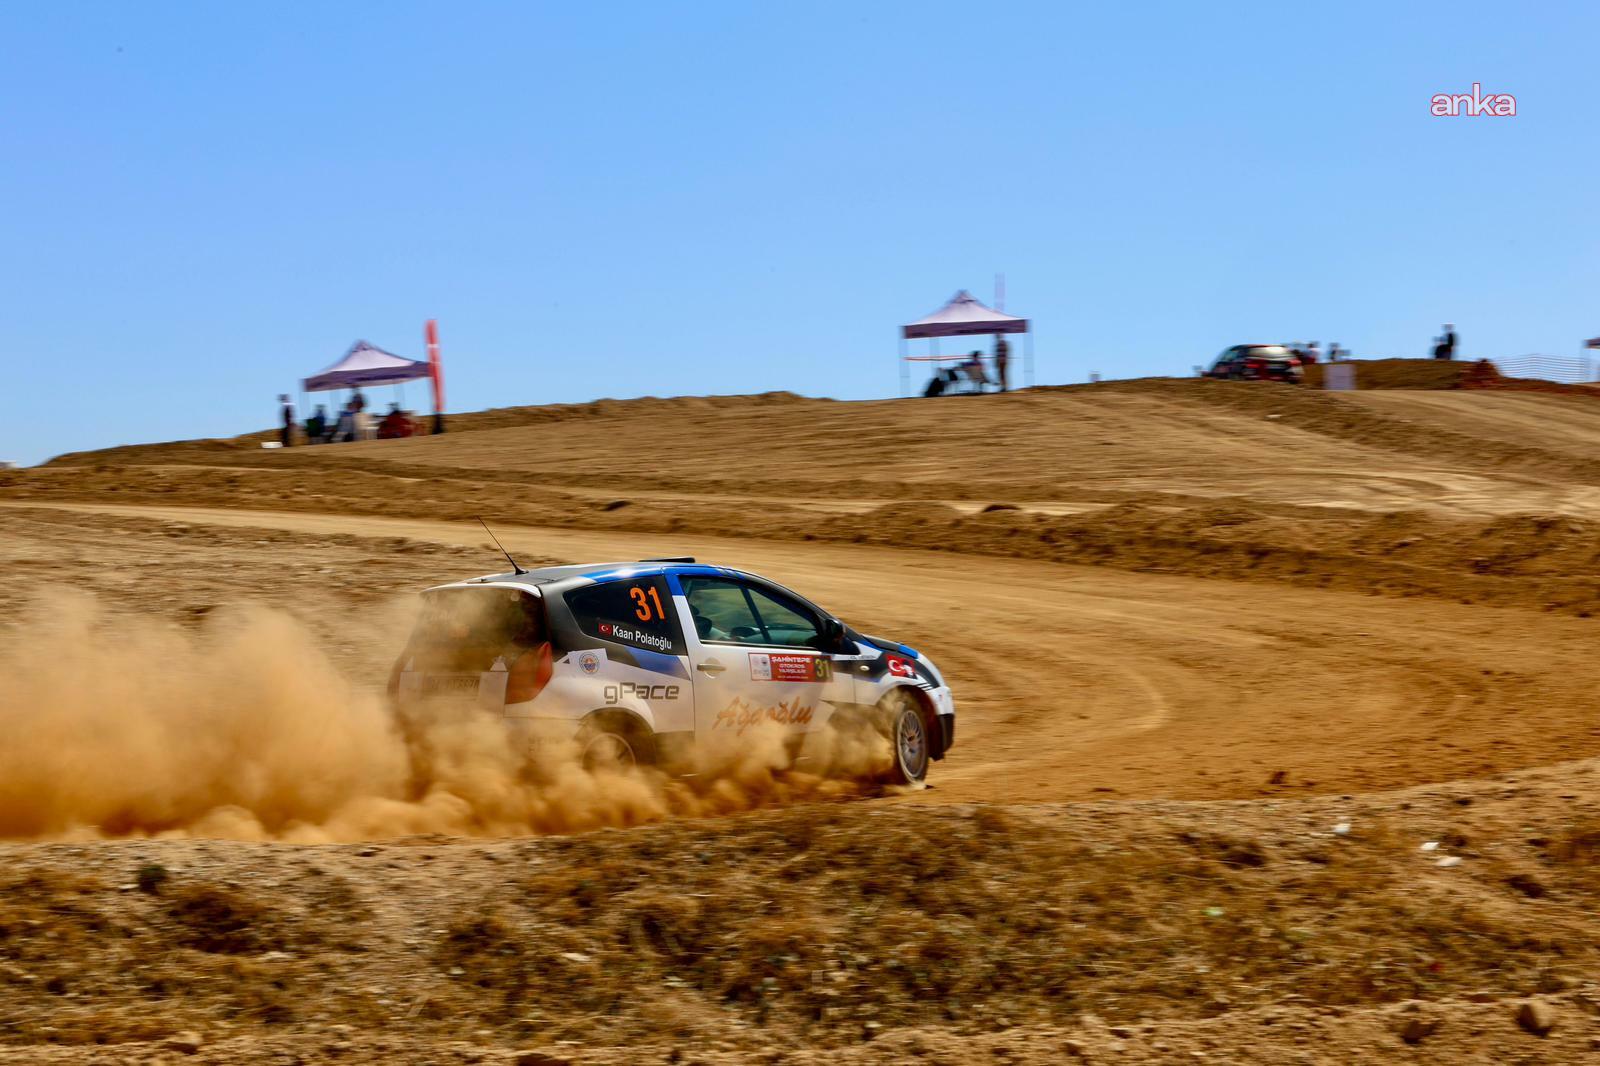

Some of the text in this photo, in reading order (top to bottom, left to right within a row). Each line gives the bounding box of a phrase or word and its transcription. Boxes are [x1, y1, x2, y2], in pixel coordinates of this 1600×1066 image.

[629, 586, 665, 622] 31
[612, 625, 672, 650] Kaan Polatoğlu
[815, 658, 831, 678] 31
